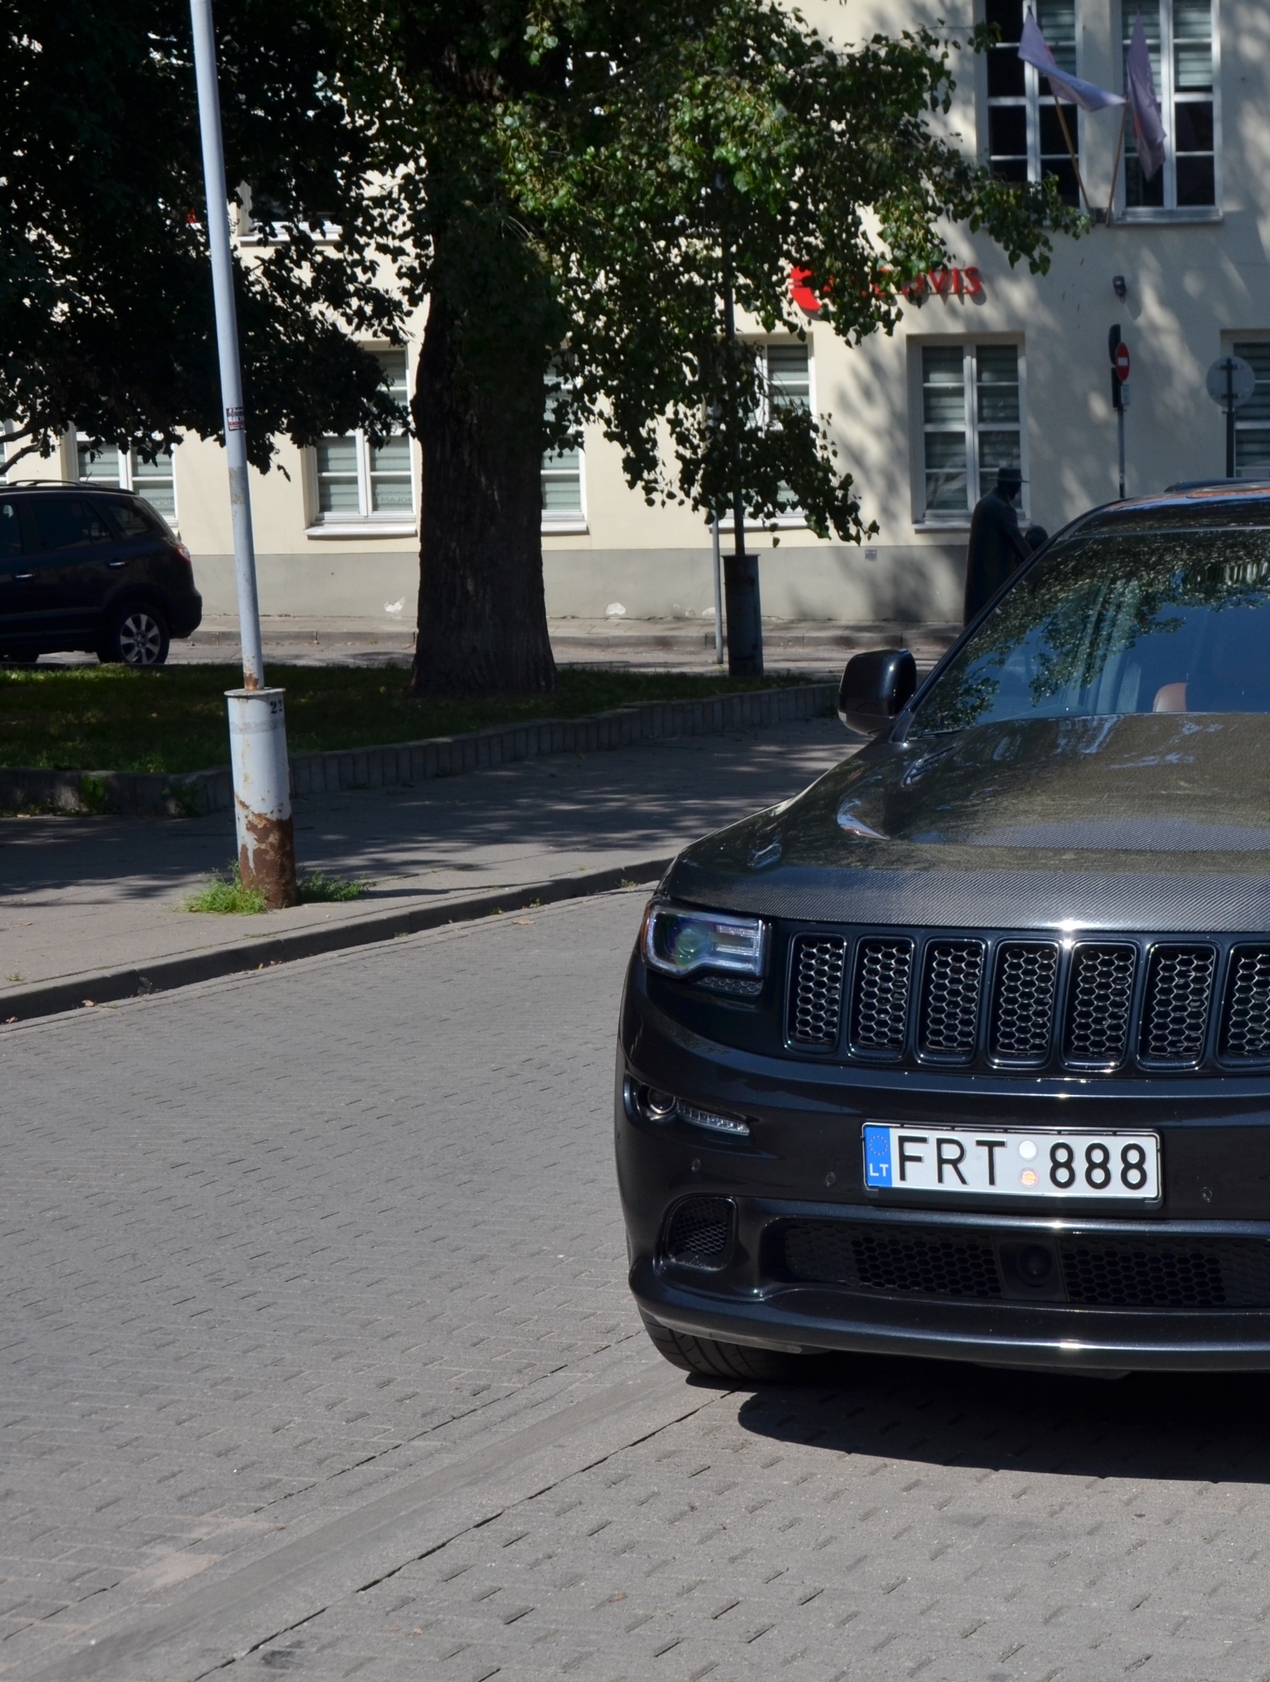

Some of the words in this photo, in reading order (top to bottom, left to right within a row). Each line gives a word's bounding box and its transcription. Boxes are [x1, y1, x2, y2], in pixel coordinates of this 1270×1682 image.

[869, 1163, 889, 1178] LT
[897, 1134, 1008, 1187] FRT
[1049, 1141, 1148, 1190] 888
